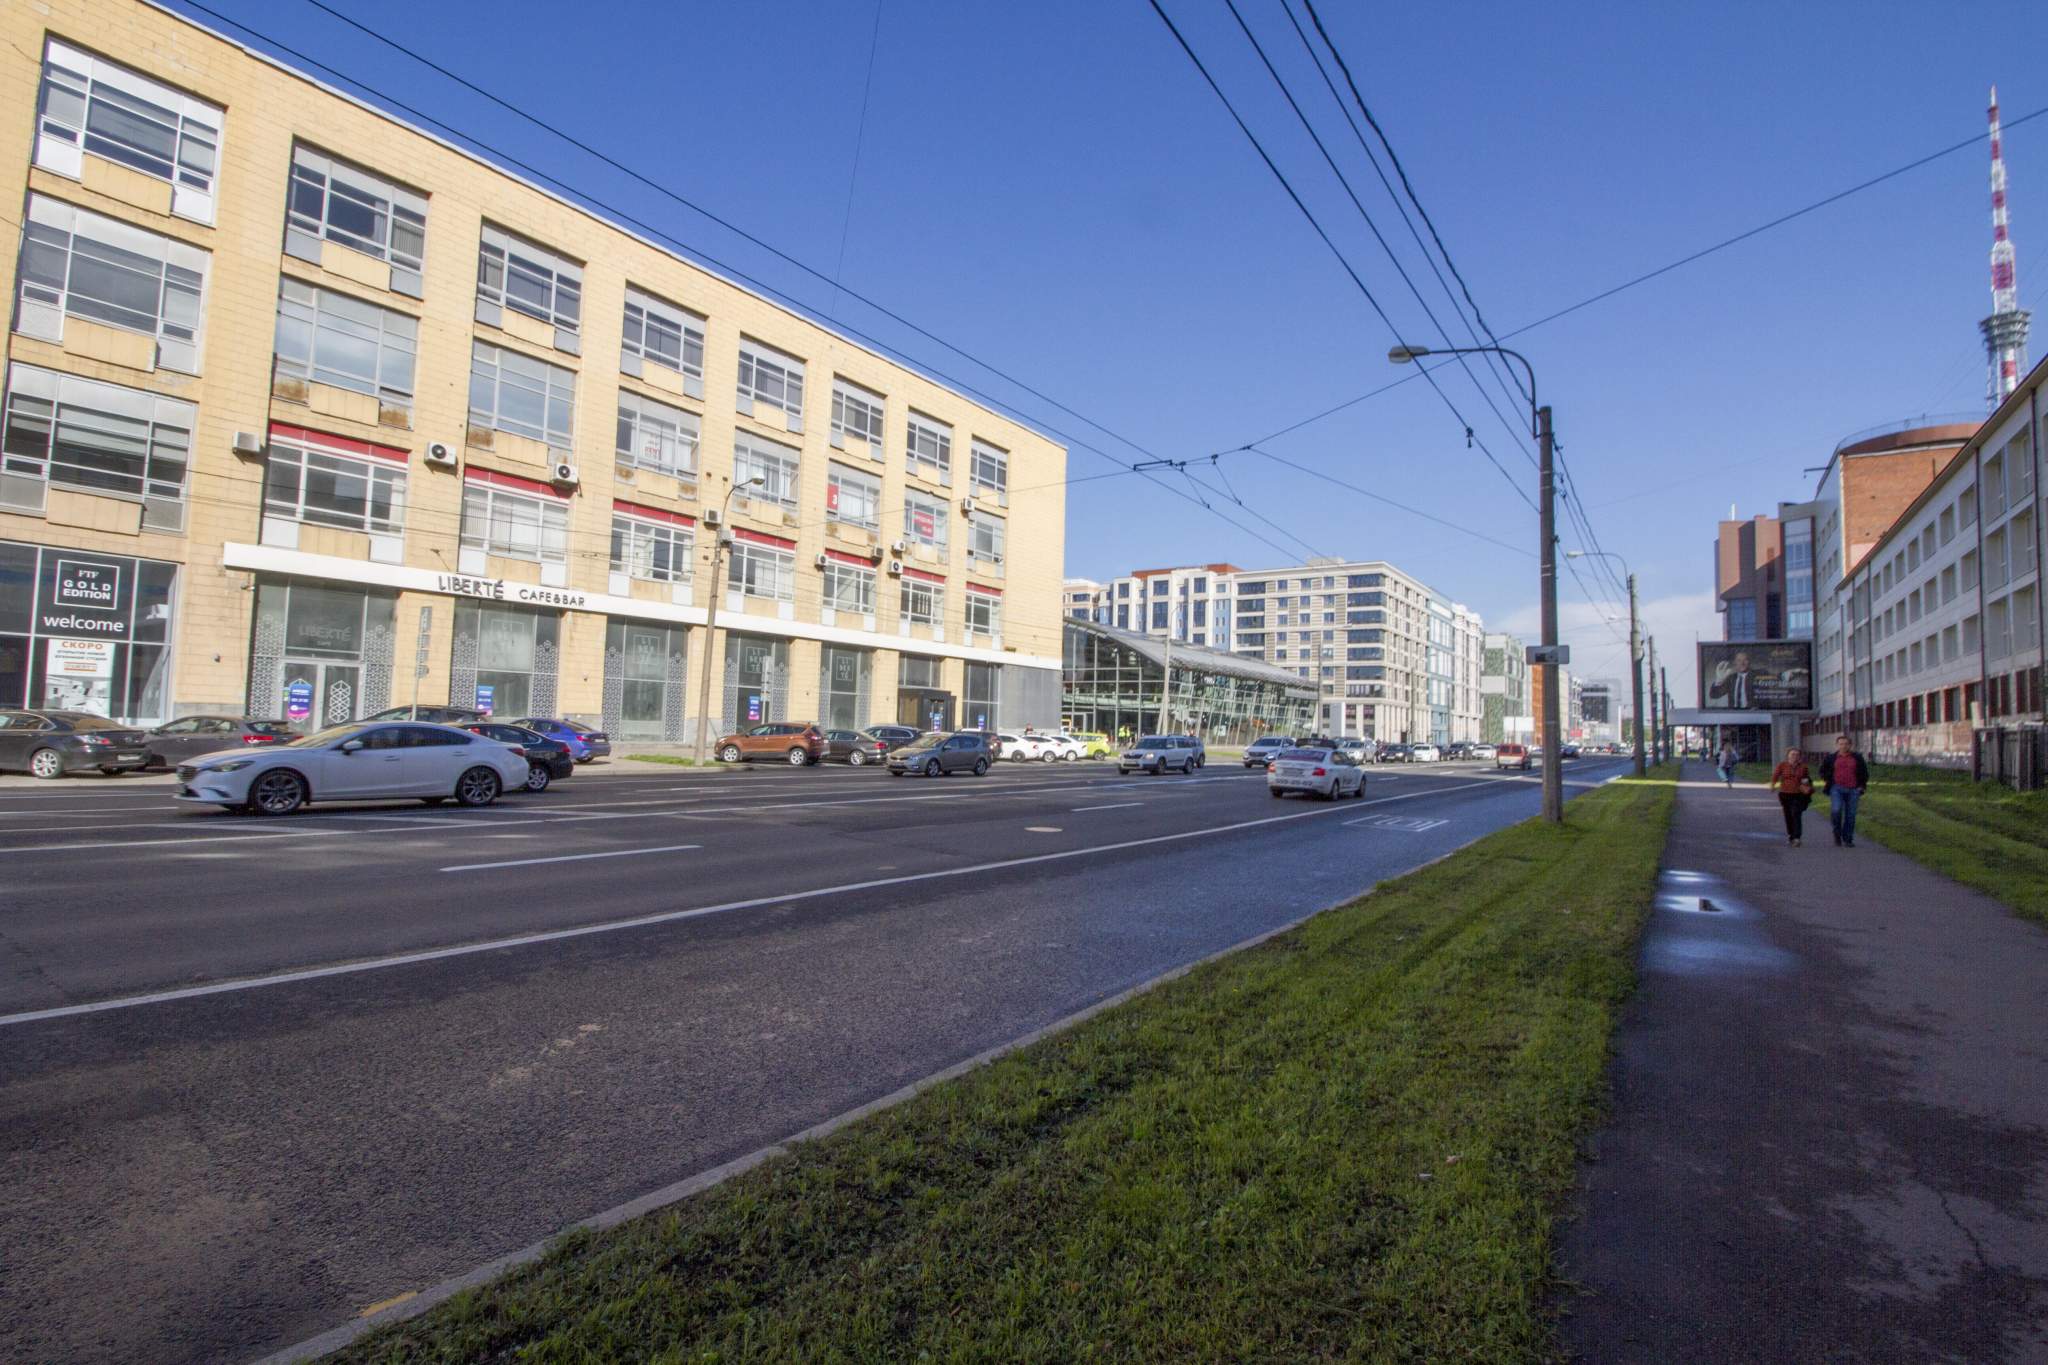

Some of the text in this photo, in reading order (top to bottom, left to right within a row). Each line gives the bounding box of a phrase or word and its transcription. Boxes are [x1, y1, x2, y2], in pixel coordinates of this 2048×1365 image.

[63, 579, 112, 592] GOLD
[438, 575, 586, 607] LIBERTÉ CAFE&BAR
[63, 588, 111, 600] EDITION
[43, 614, 125, 632] welcome
